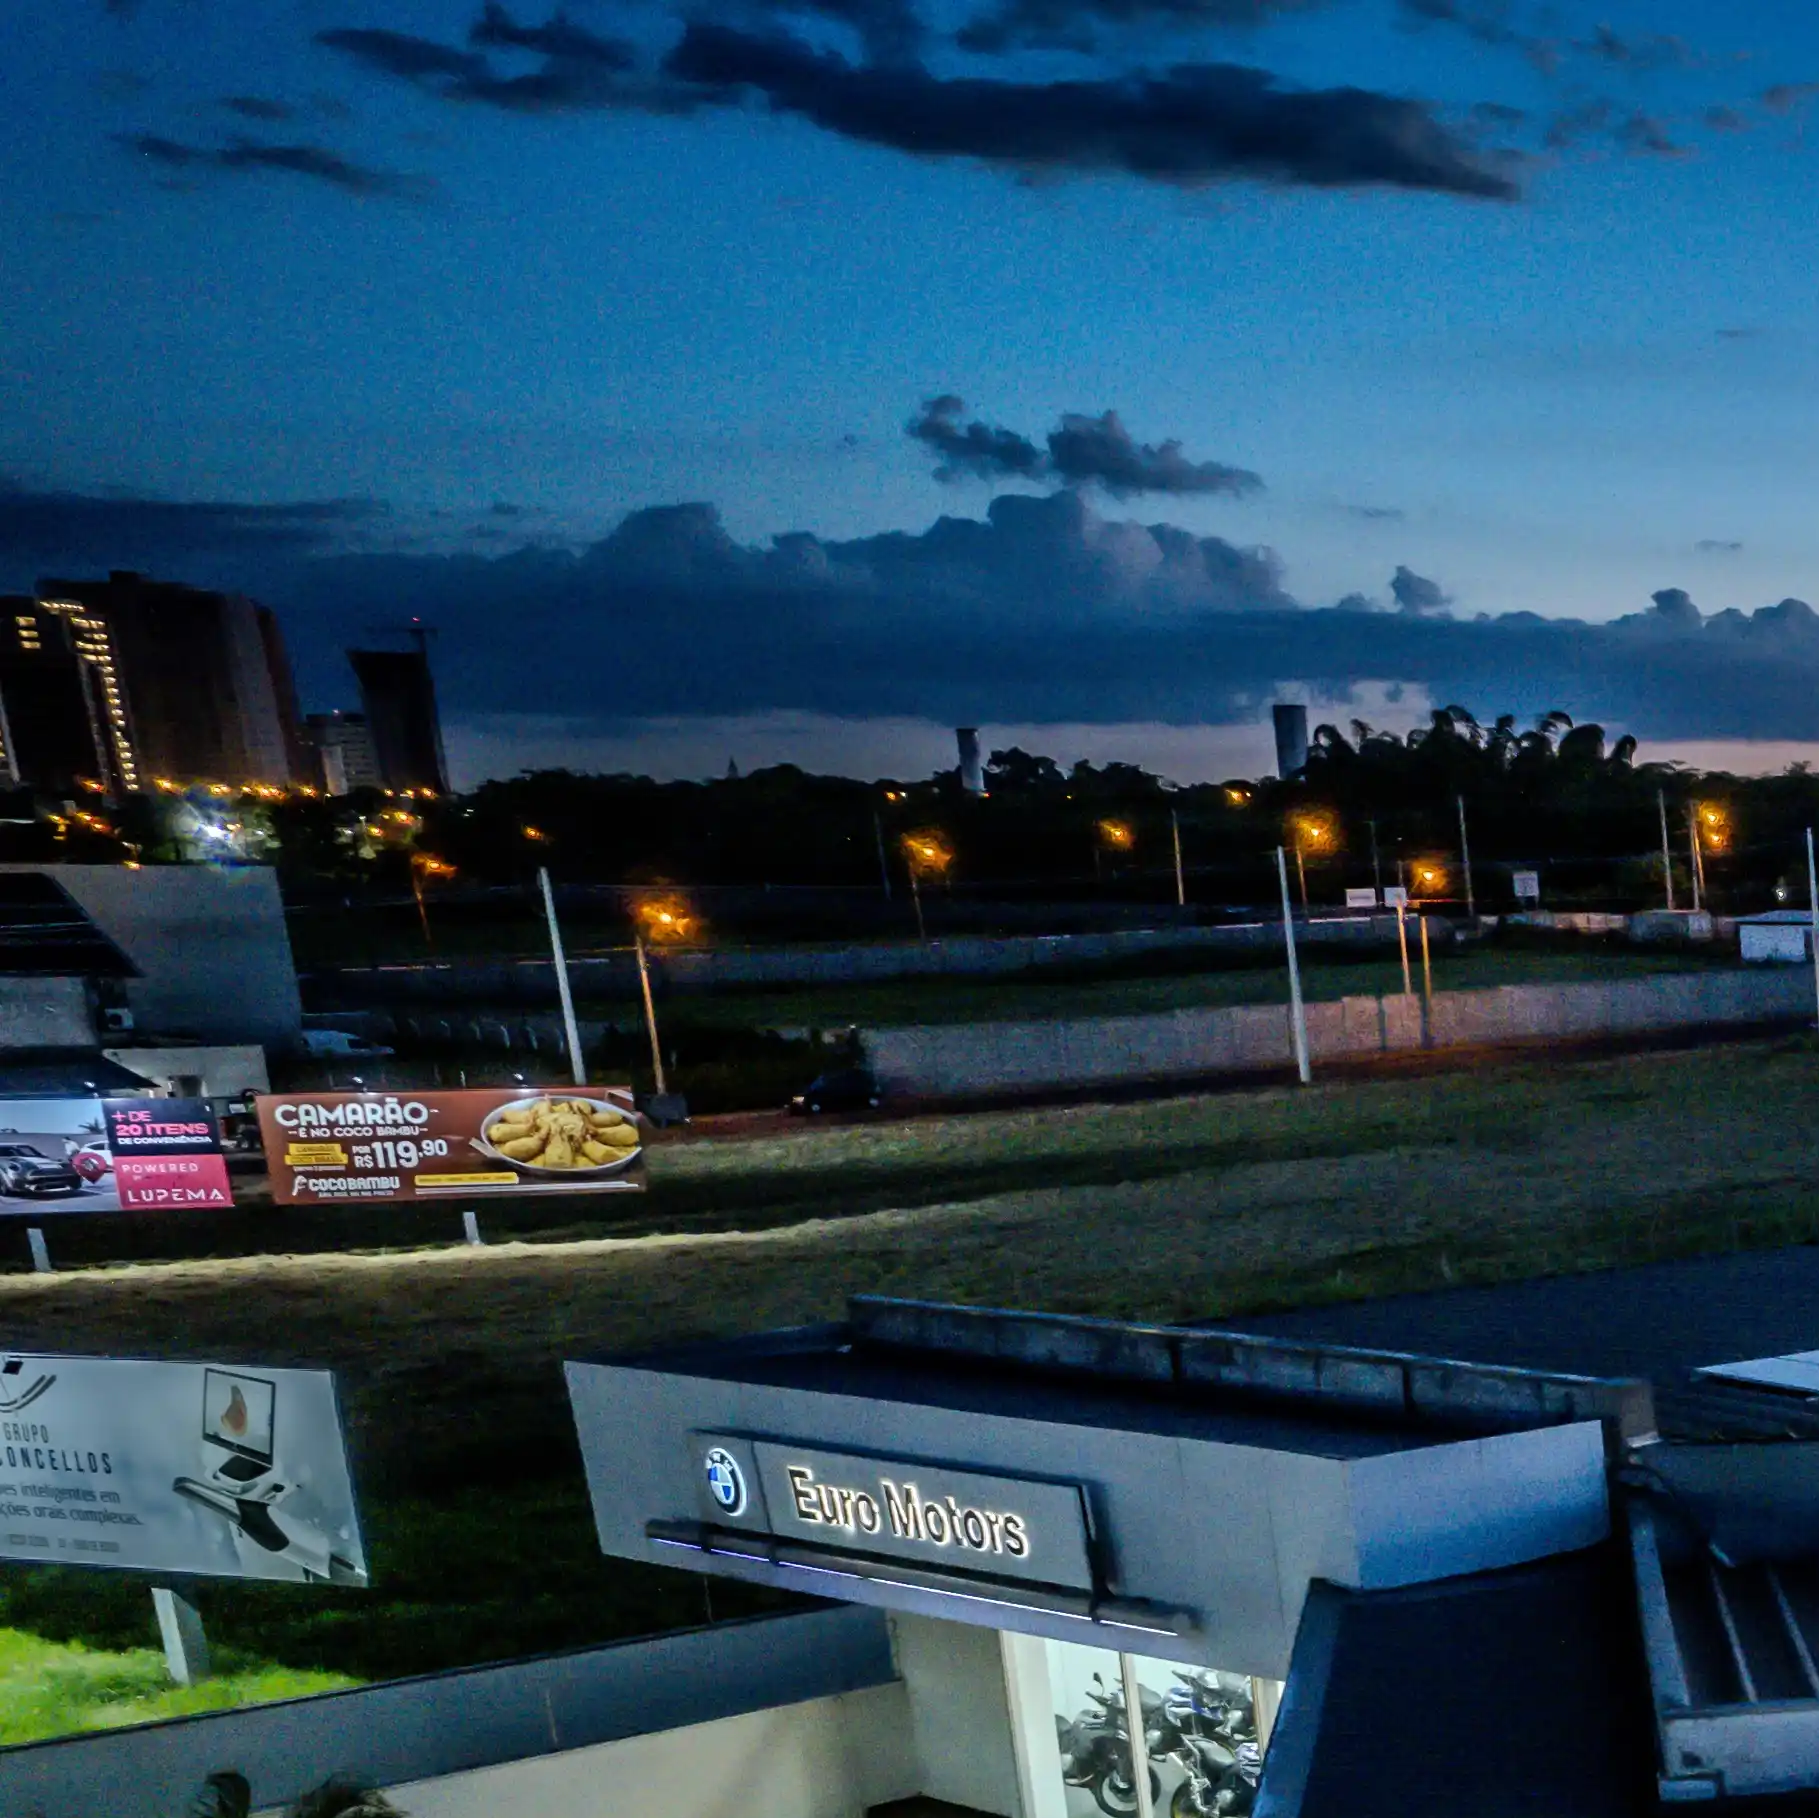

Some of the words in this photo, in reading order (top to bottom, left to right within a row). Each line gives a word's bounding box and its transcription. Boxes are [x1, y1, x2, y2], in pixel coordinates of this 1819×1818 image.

[128, 1110, 152, 1121] DE
[274, 1096, 428, 1127] CAMARÃO
[116, 1124, 142, 1136] 20
[145, 1123, 209, 1136] ITENS
[311, 1127, 331, 1138] NO
[333, 1127, 373, 1137] COCO
[121, 1162, 199, 1173] POWERED
[354, 1155, 374, 1168] R$
[127, 1188, 224, 1203] LUPEMA
[3, 1422, 49, 1443] GRUPO
[0, 1446, 112, 1474] ONCELLOS
[787, 1465, 880, 1533] Euro
[880, 1479, 1030, 1559] Motors
